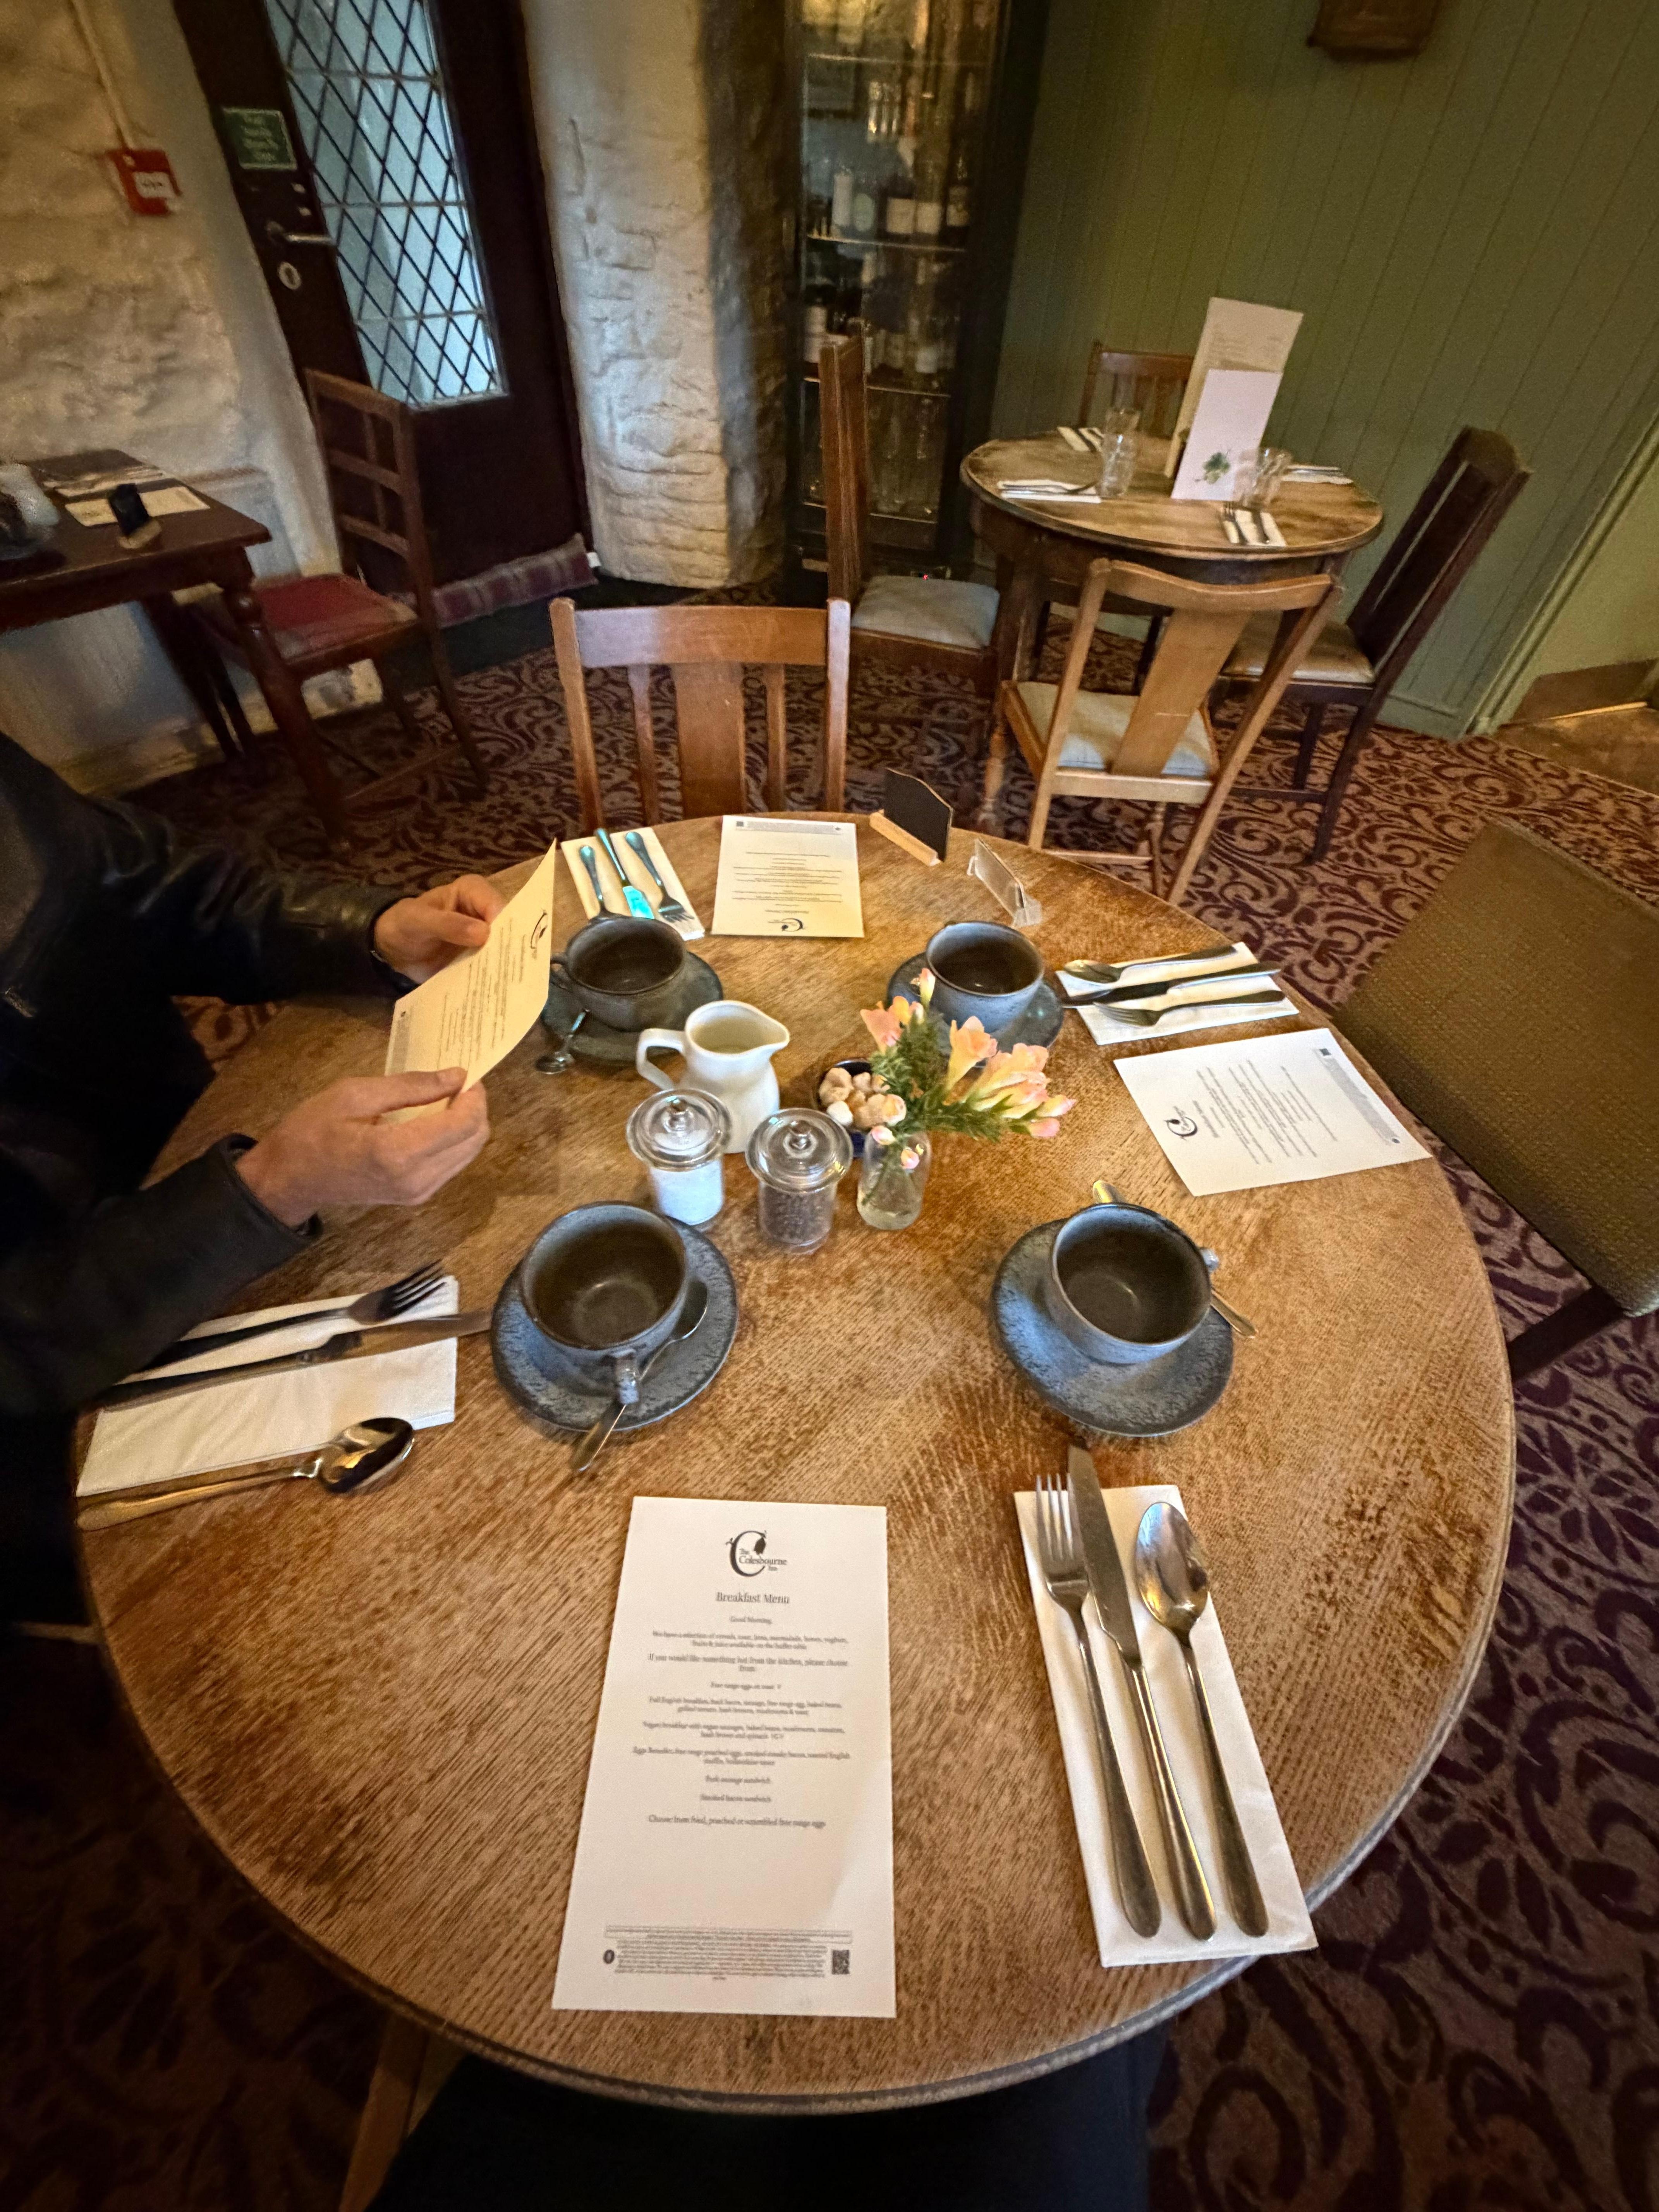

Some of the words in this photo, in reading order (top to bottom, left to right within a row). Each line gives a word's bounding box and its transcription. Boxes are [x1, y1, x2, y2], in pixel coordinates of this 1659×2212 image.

[738, 1555, 787, 1565] Colesbourne
[716, 1592, 761, 1603] Breakfast
[764, 1594, 790, 1604] Menu
[648, 1653, 654, 1661] If
